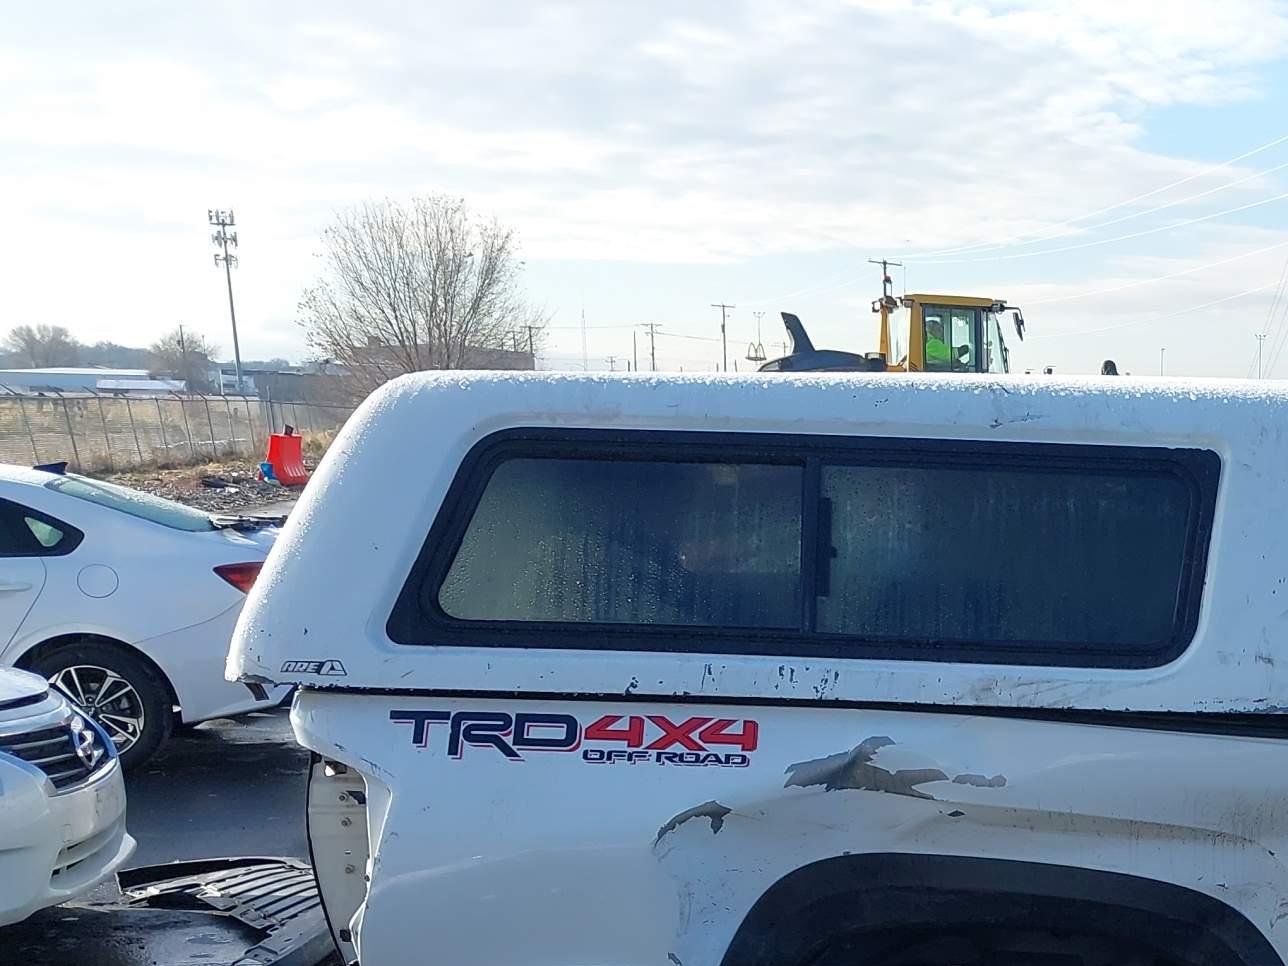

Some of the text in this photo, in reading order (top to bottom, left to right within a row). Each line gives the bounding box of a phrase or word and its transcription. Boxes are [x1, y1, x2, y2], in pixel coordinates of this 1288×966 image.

[389, 710, 582, 762] TRD
[582, 749, 751, 768] OFF ROAD
